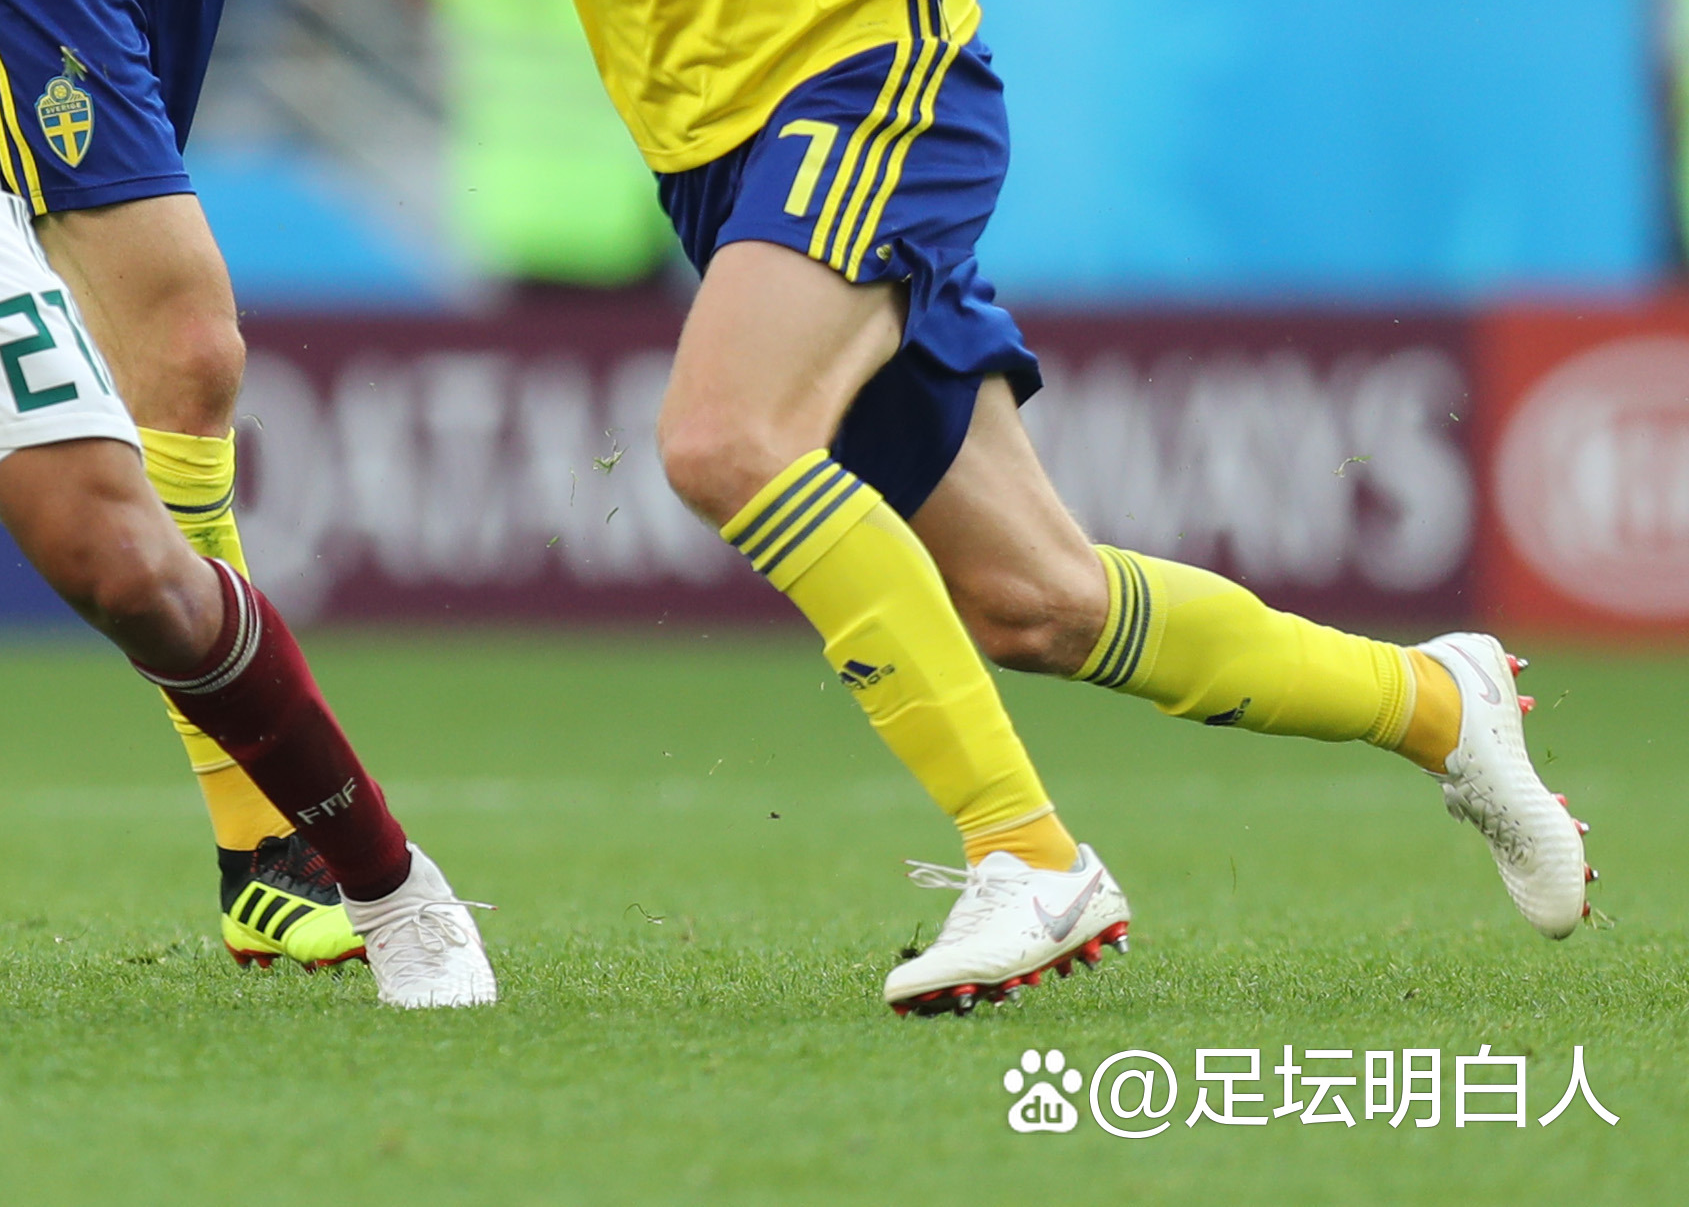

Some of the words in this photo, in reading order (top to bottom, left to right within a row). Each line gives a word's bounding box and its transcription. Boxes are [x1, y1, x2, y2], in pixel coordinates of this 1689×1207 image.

[45, 101, 82, 115] SVERIGE
[778, 119, 839, 217] 7
[296, 777, 357, 825] FMF
